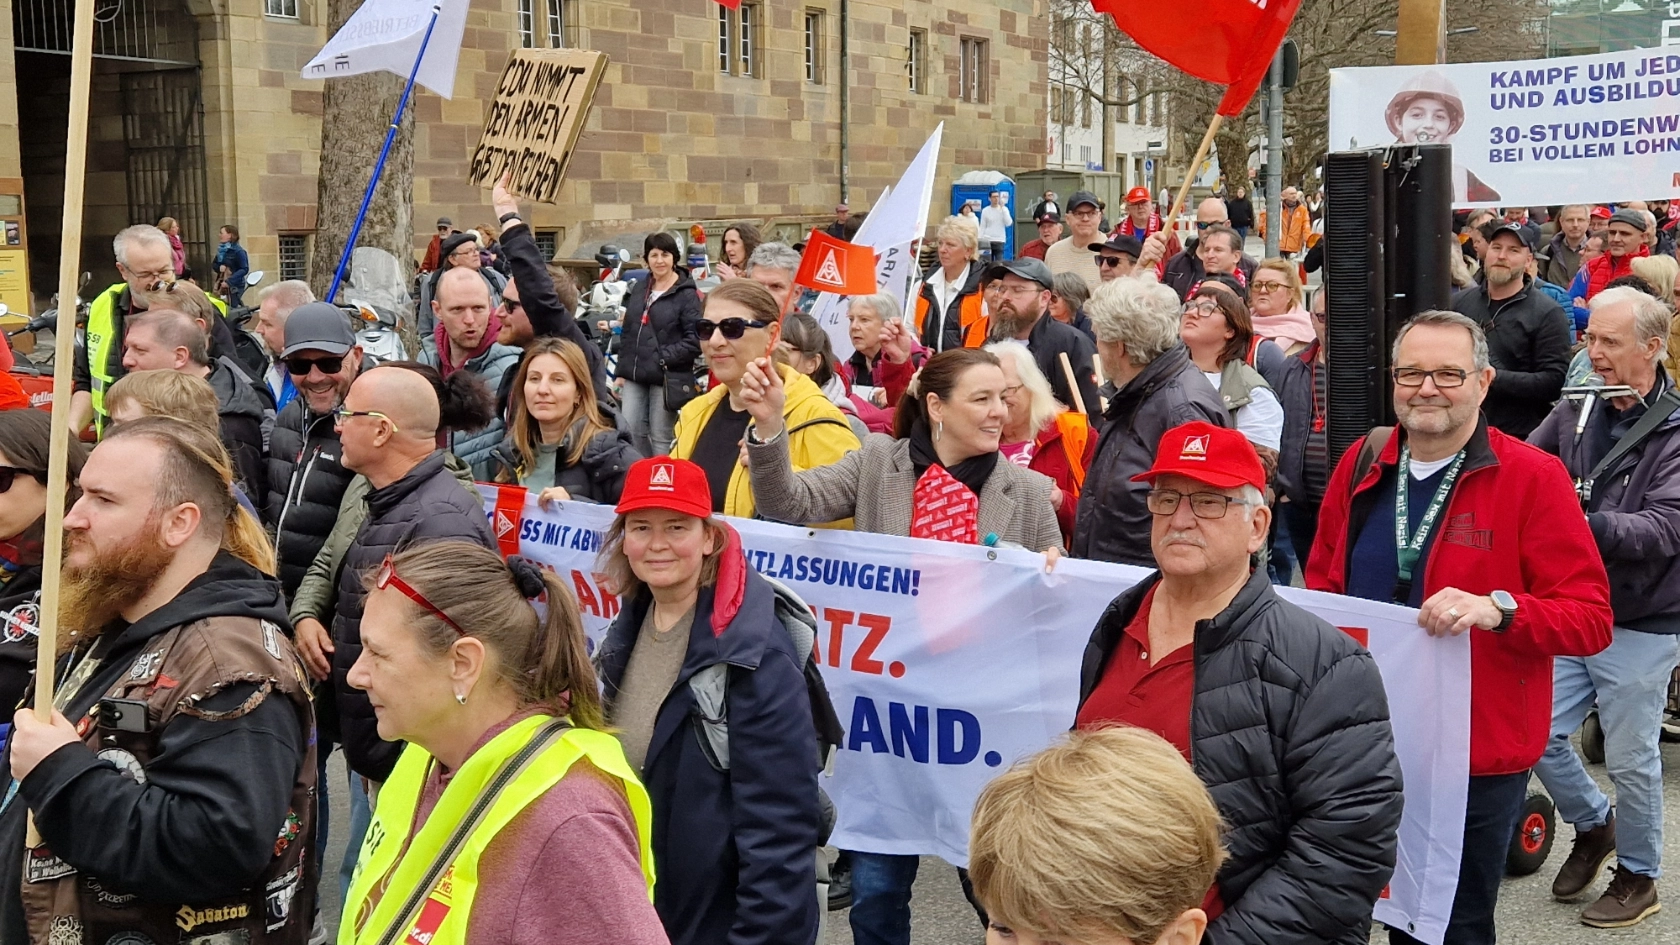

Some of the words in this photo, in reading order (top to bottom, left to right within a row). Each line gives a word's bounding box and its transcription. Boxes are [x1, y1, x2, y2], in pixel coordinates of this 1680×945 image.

[499, 58, 534, 97] CDU
[529, 60, 586, 103] NIMMT
[1490, 65, 1579, 88] KAMPF
[1588, 61, 1626, 81] UM
[1490, 91, 1544, 110] UND
[485, 100, 516, 137] DEN
[509, 99, 570, 145] ARMEN
[1489, 147, 1524, 163] BEI
[1532, 142, 1615, 160] VOLLEM
[1624, 137, 1680, 155] LOHN
[1398, 474, 1407, 492] Sex
[1397, 495, 1407, 513] mit
[1412, 525, 1430, 550] Kein
[1425, 503, 1440, 522] Sex
[1438, 484, 1451, 502] mit
[542, 522, 572, 547] MIT
[838, 696, 1002, 768] AND.
[176, 904, 248, 933] Sabaton
